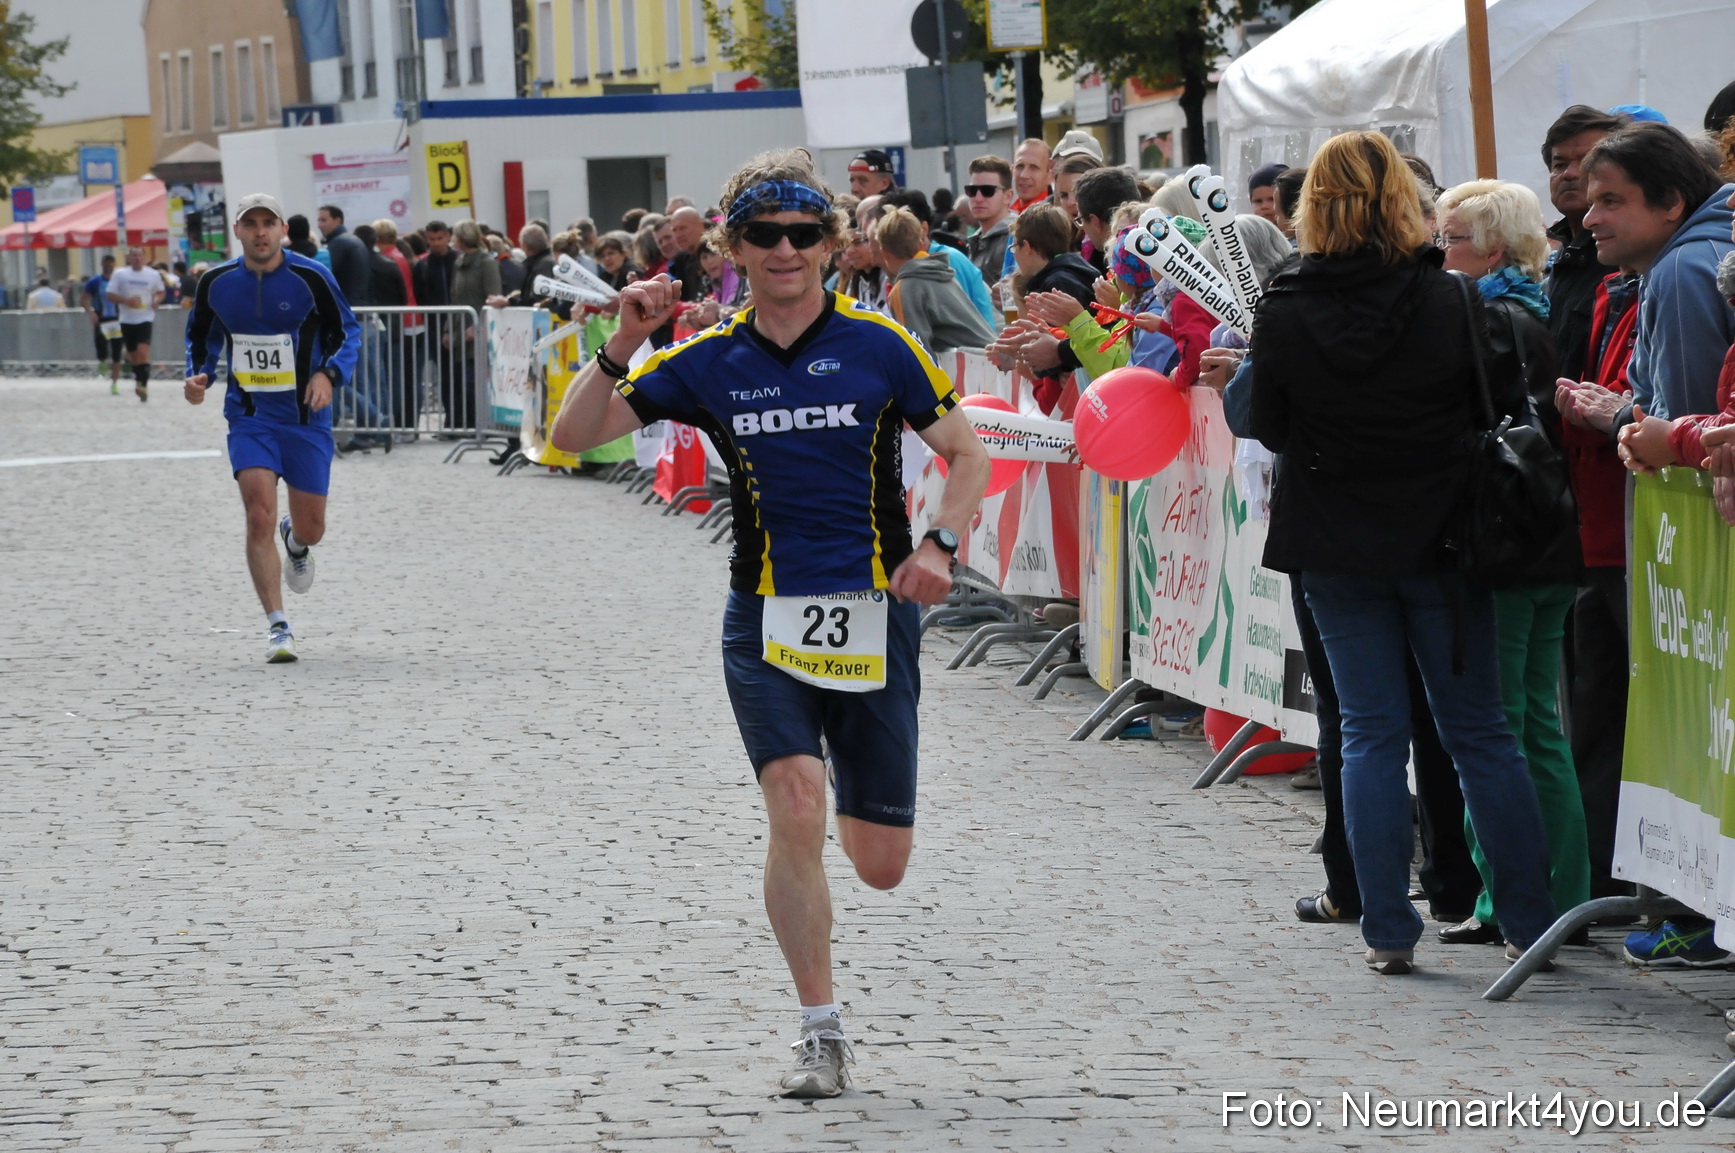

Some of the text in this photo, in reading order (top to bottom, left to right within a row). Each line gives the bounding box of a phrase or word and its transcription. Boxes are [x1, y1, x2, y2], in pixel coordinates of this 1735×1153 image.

[429, 144, 464, 158] Block
[438, 162, 462, 194] D
[244, 349, 282, 370] 194
[250, 375, 277, 384] Robert
[729, 387, 781, 401] TEAM
[732, 403, 860, 437] BOCK
[1657, 512, 1676, 564] Der
[1647, 560, 1688, 659] Neue
[801, 604, 850, 648] 23
[780, 648, 870, 676] Franz Xaver
[1301, 672, 1315, 696] Le
